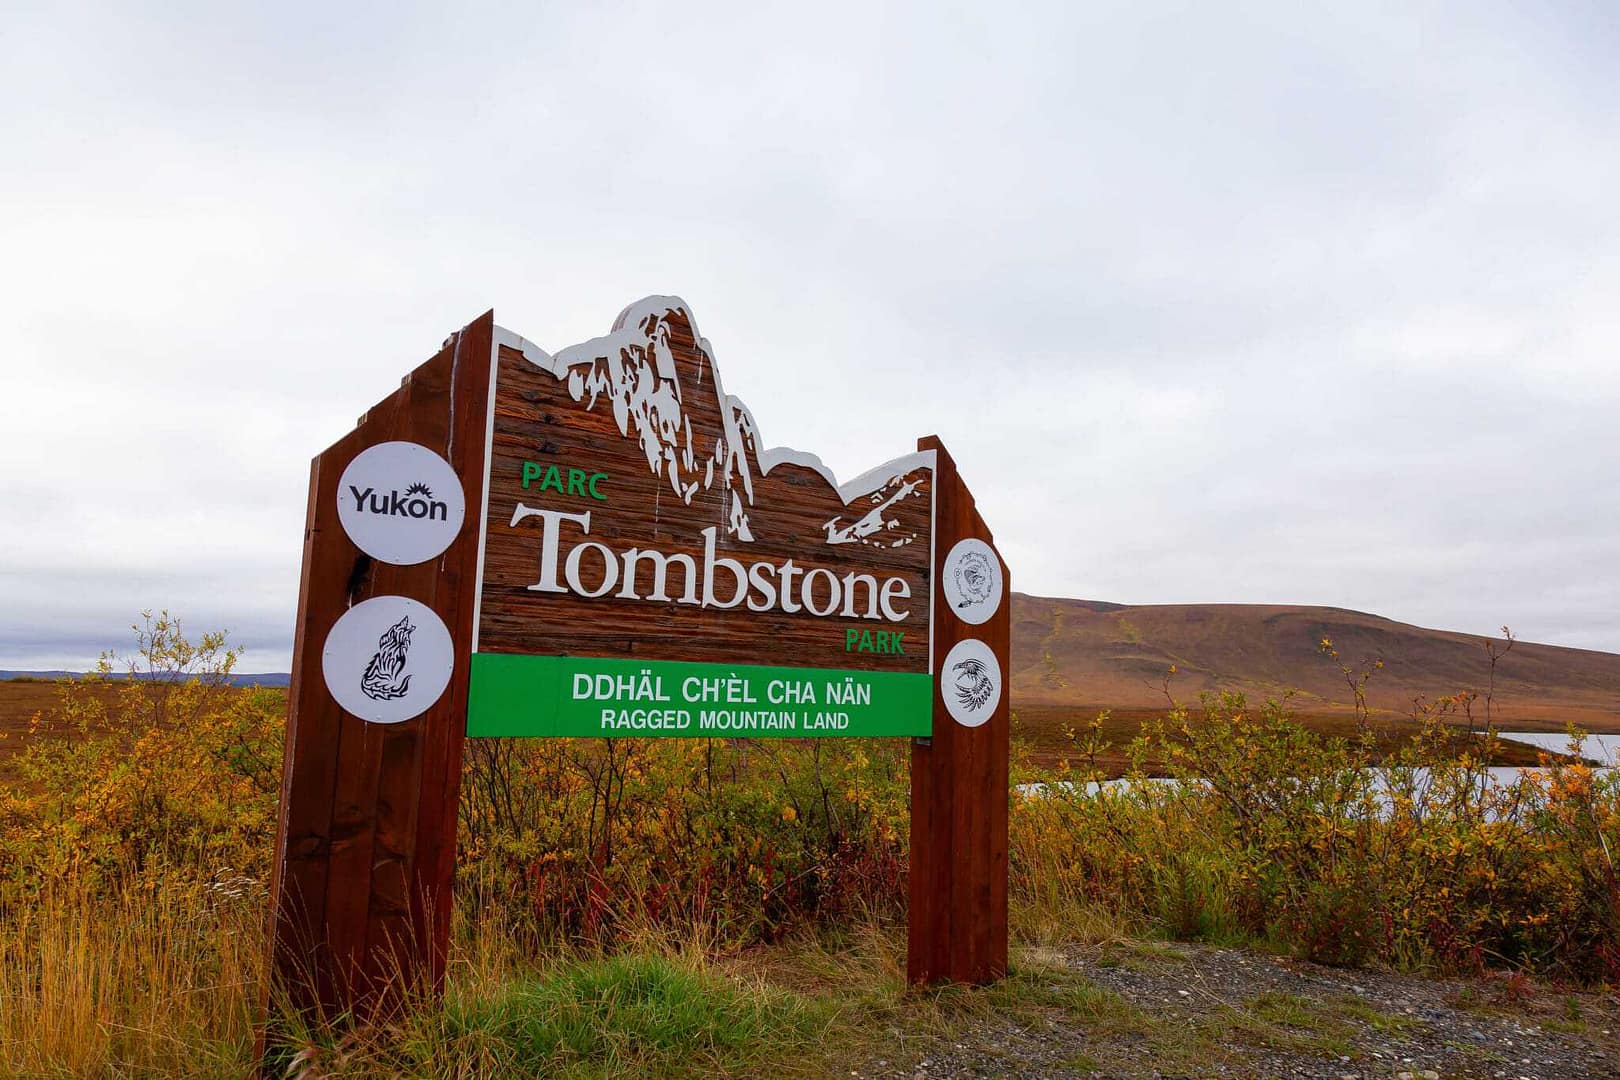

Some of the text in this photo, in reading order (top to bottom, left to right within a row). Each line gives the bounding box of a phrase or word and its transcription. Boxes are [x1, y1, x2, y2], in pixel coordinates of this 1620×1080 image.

[521, 461, 610, 501] PARC
[349, 485, 448, 522] Yukon
[509, 502, 912, 622] Tombstone
[845, 628, 906, 656] PARK
[572, 669, 671, 702] DDHÄL
[767, 680, 817, 705] CHA
[825, 676, 872, 706] NÄN
[600, 709, 850, 730] RAGGED MOUNTAIN LAND
